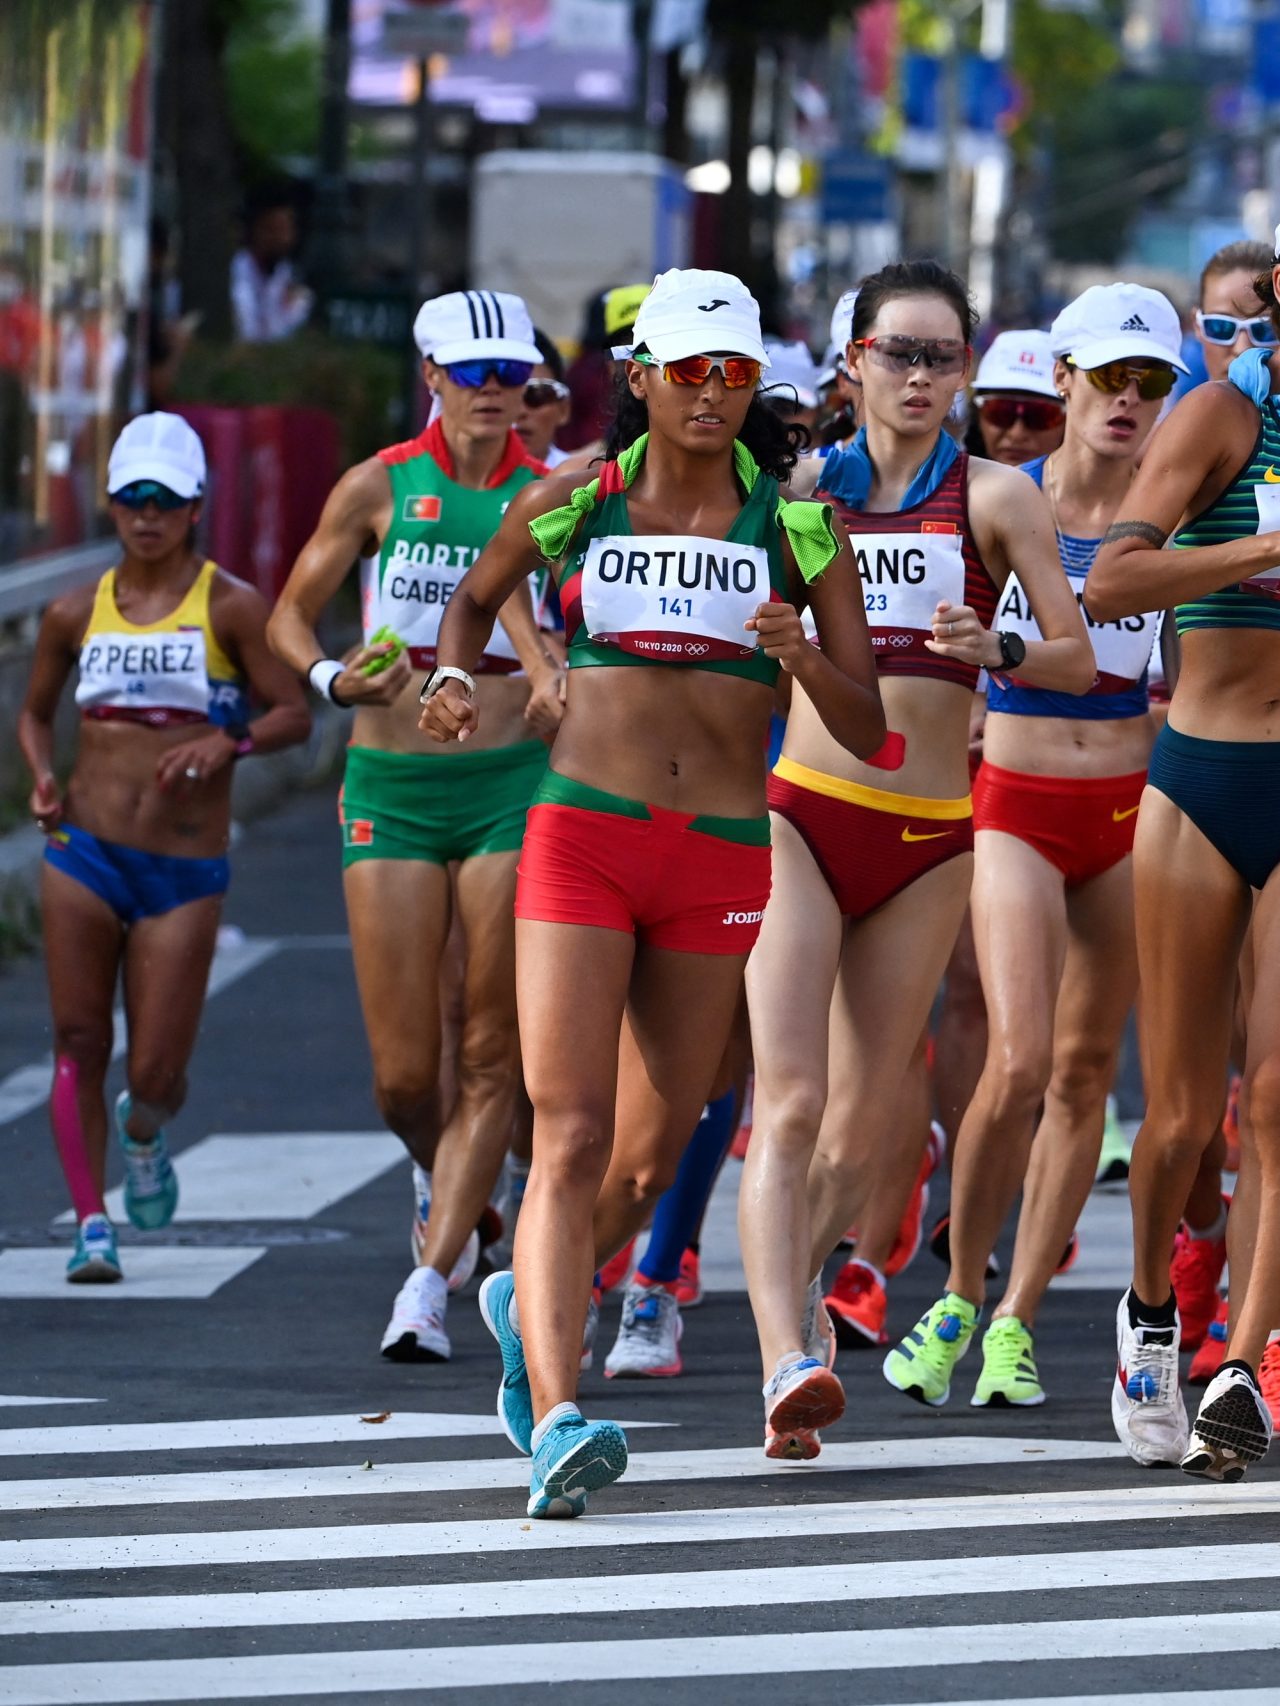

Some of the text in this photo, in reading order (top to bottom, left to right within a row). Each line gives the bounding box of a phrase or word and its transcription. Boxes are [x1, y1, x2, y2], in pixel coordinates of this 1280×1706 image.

[598, 549, 756, 594] ORTUNO
[856, 549, 926, 585] ANG
[391, 577, 455, 605] CABE
[658, 597, 693, 617] 141
[634, 640, 682, 653] TOKYO 2020
[871, 637, 886, 646] 020
[86, 644, 195, 674] P.PEREZ
